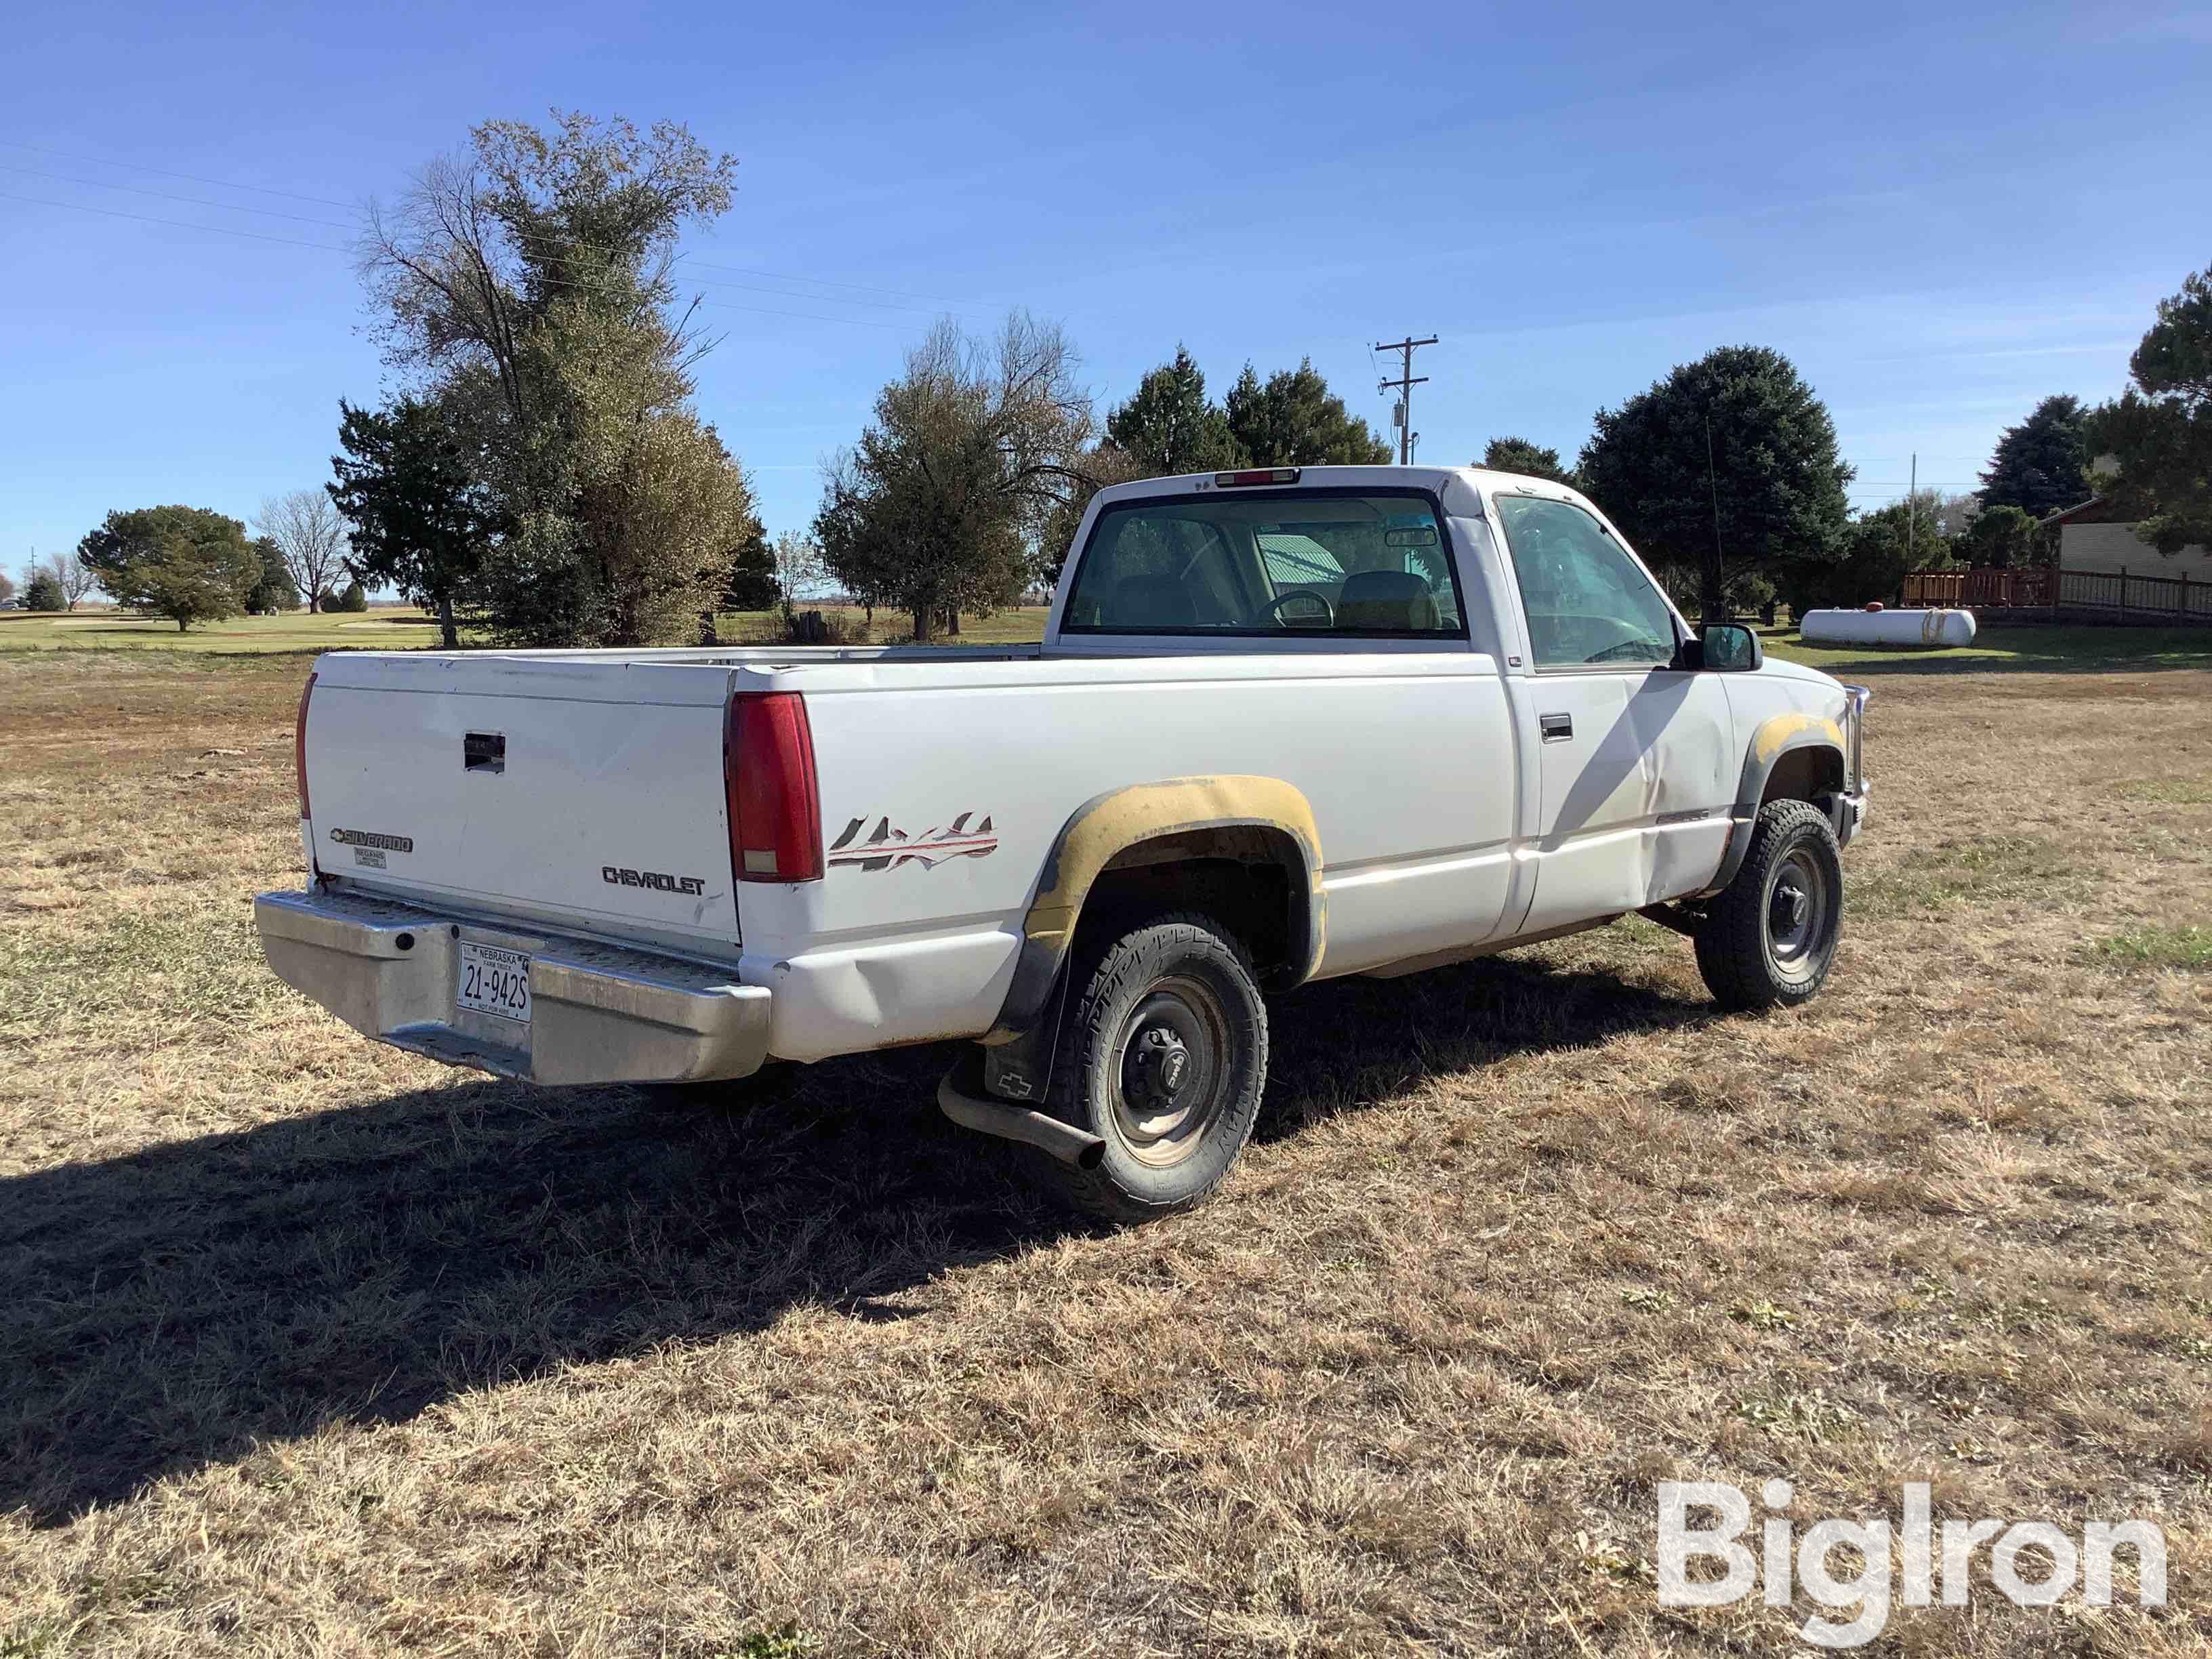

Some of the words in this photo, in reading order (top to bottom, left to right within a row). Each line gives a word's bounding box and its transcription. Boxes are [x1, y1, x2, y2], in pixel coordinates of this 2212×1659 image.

[344, 830, 412, 852] SILVERADO
[602, 866, 705, 896] CHEVROLET
[480, 948, 516, 965] NEBRASKA
[465, 964, 527, 1009] 21-942S
